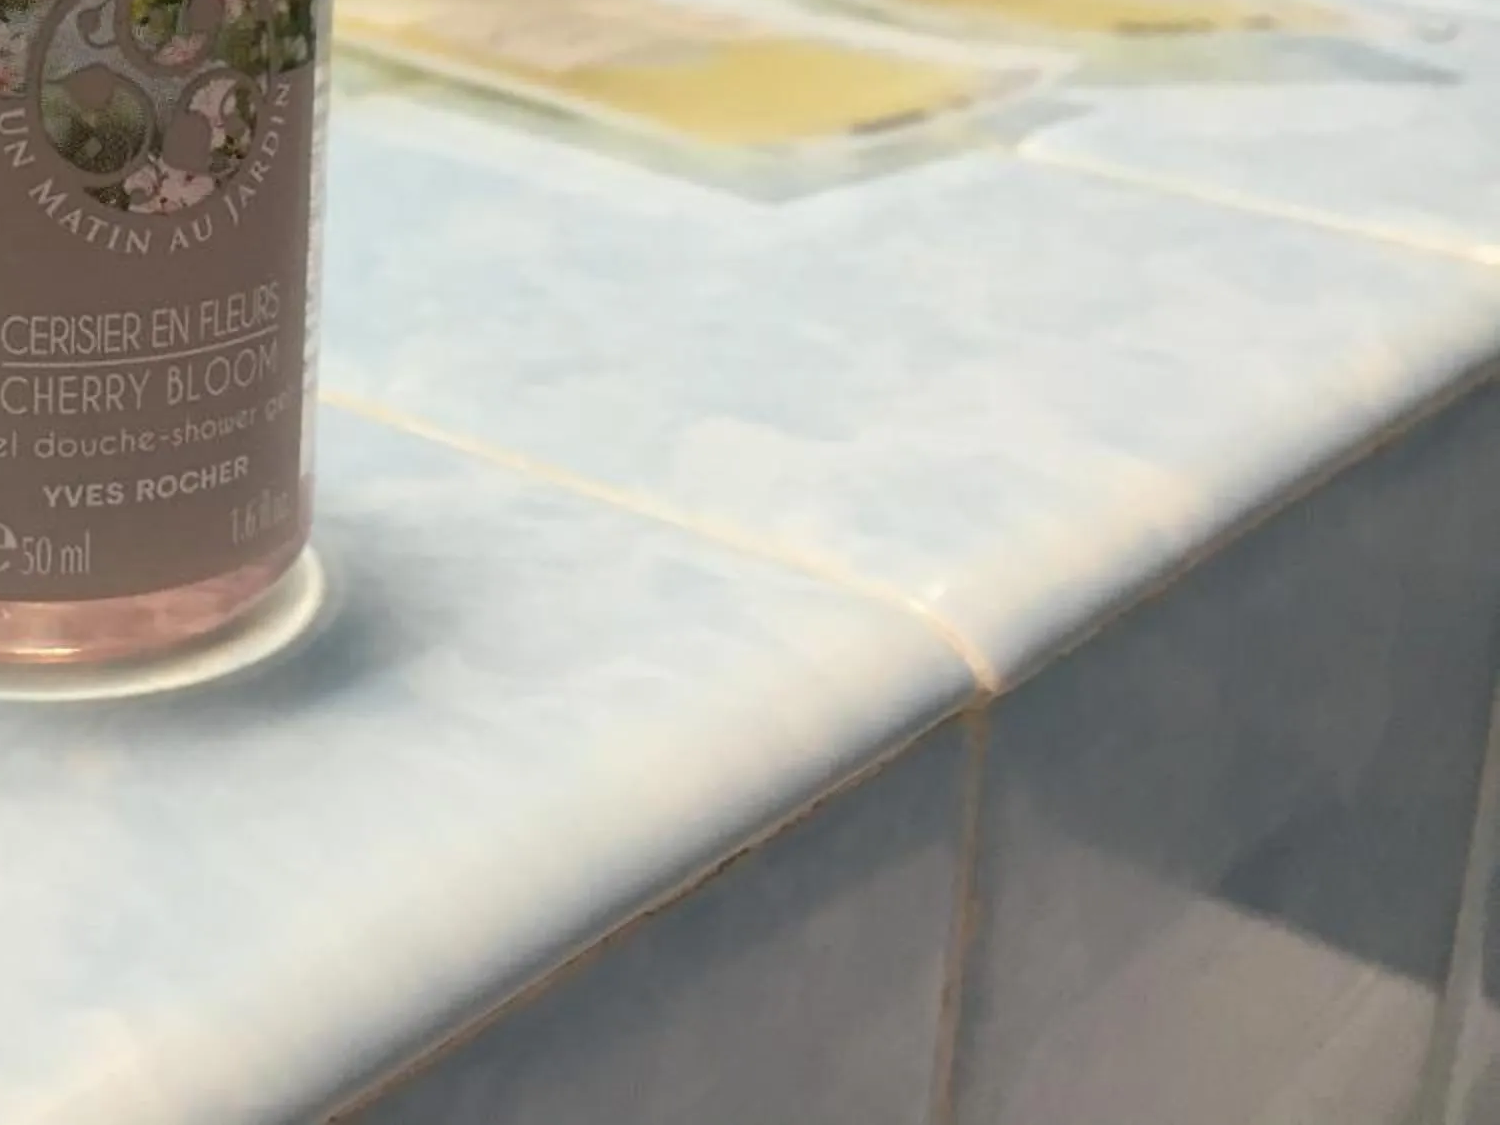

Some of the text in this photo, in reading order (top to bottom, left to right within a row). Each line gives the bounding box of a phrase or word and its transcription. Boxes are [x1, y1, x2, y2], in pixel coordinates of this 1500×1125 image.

[28, 178, 151, 255] MATIN
[169, 218, 213, 253] AU
[223, 83, 291, 225] JARDIN
[1, 282, 280, 355] CERISIER EN FLEURS
[0, 341, 278, 415] CHERRY BLOOM
[43, 455, 250, 508] YVES ROCHER
[21, 537, 51, 575] 50
[60, 531, 90, 574] ml
